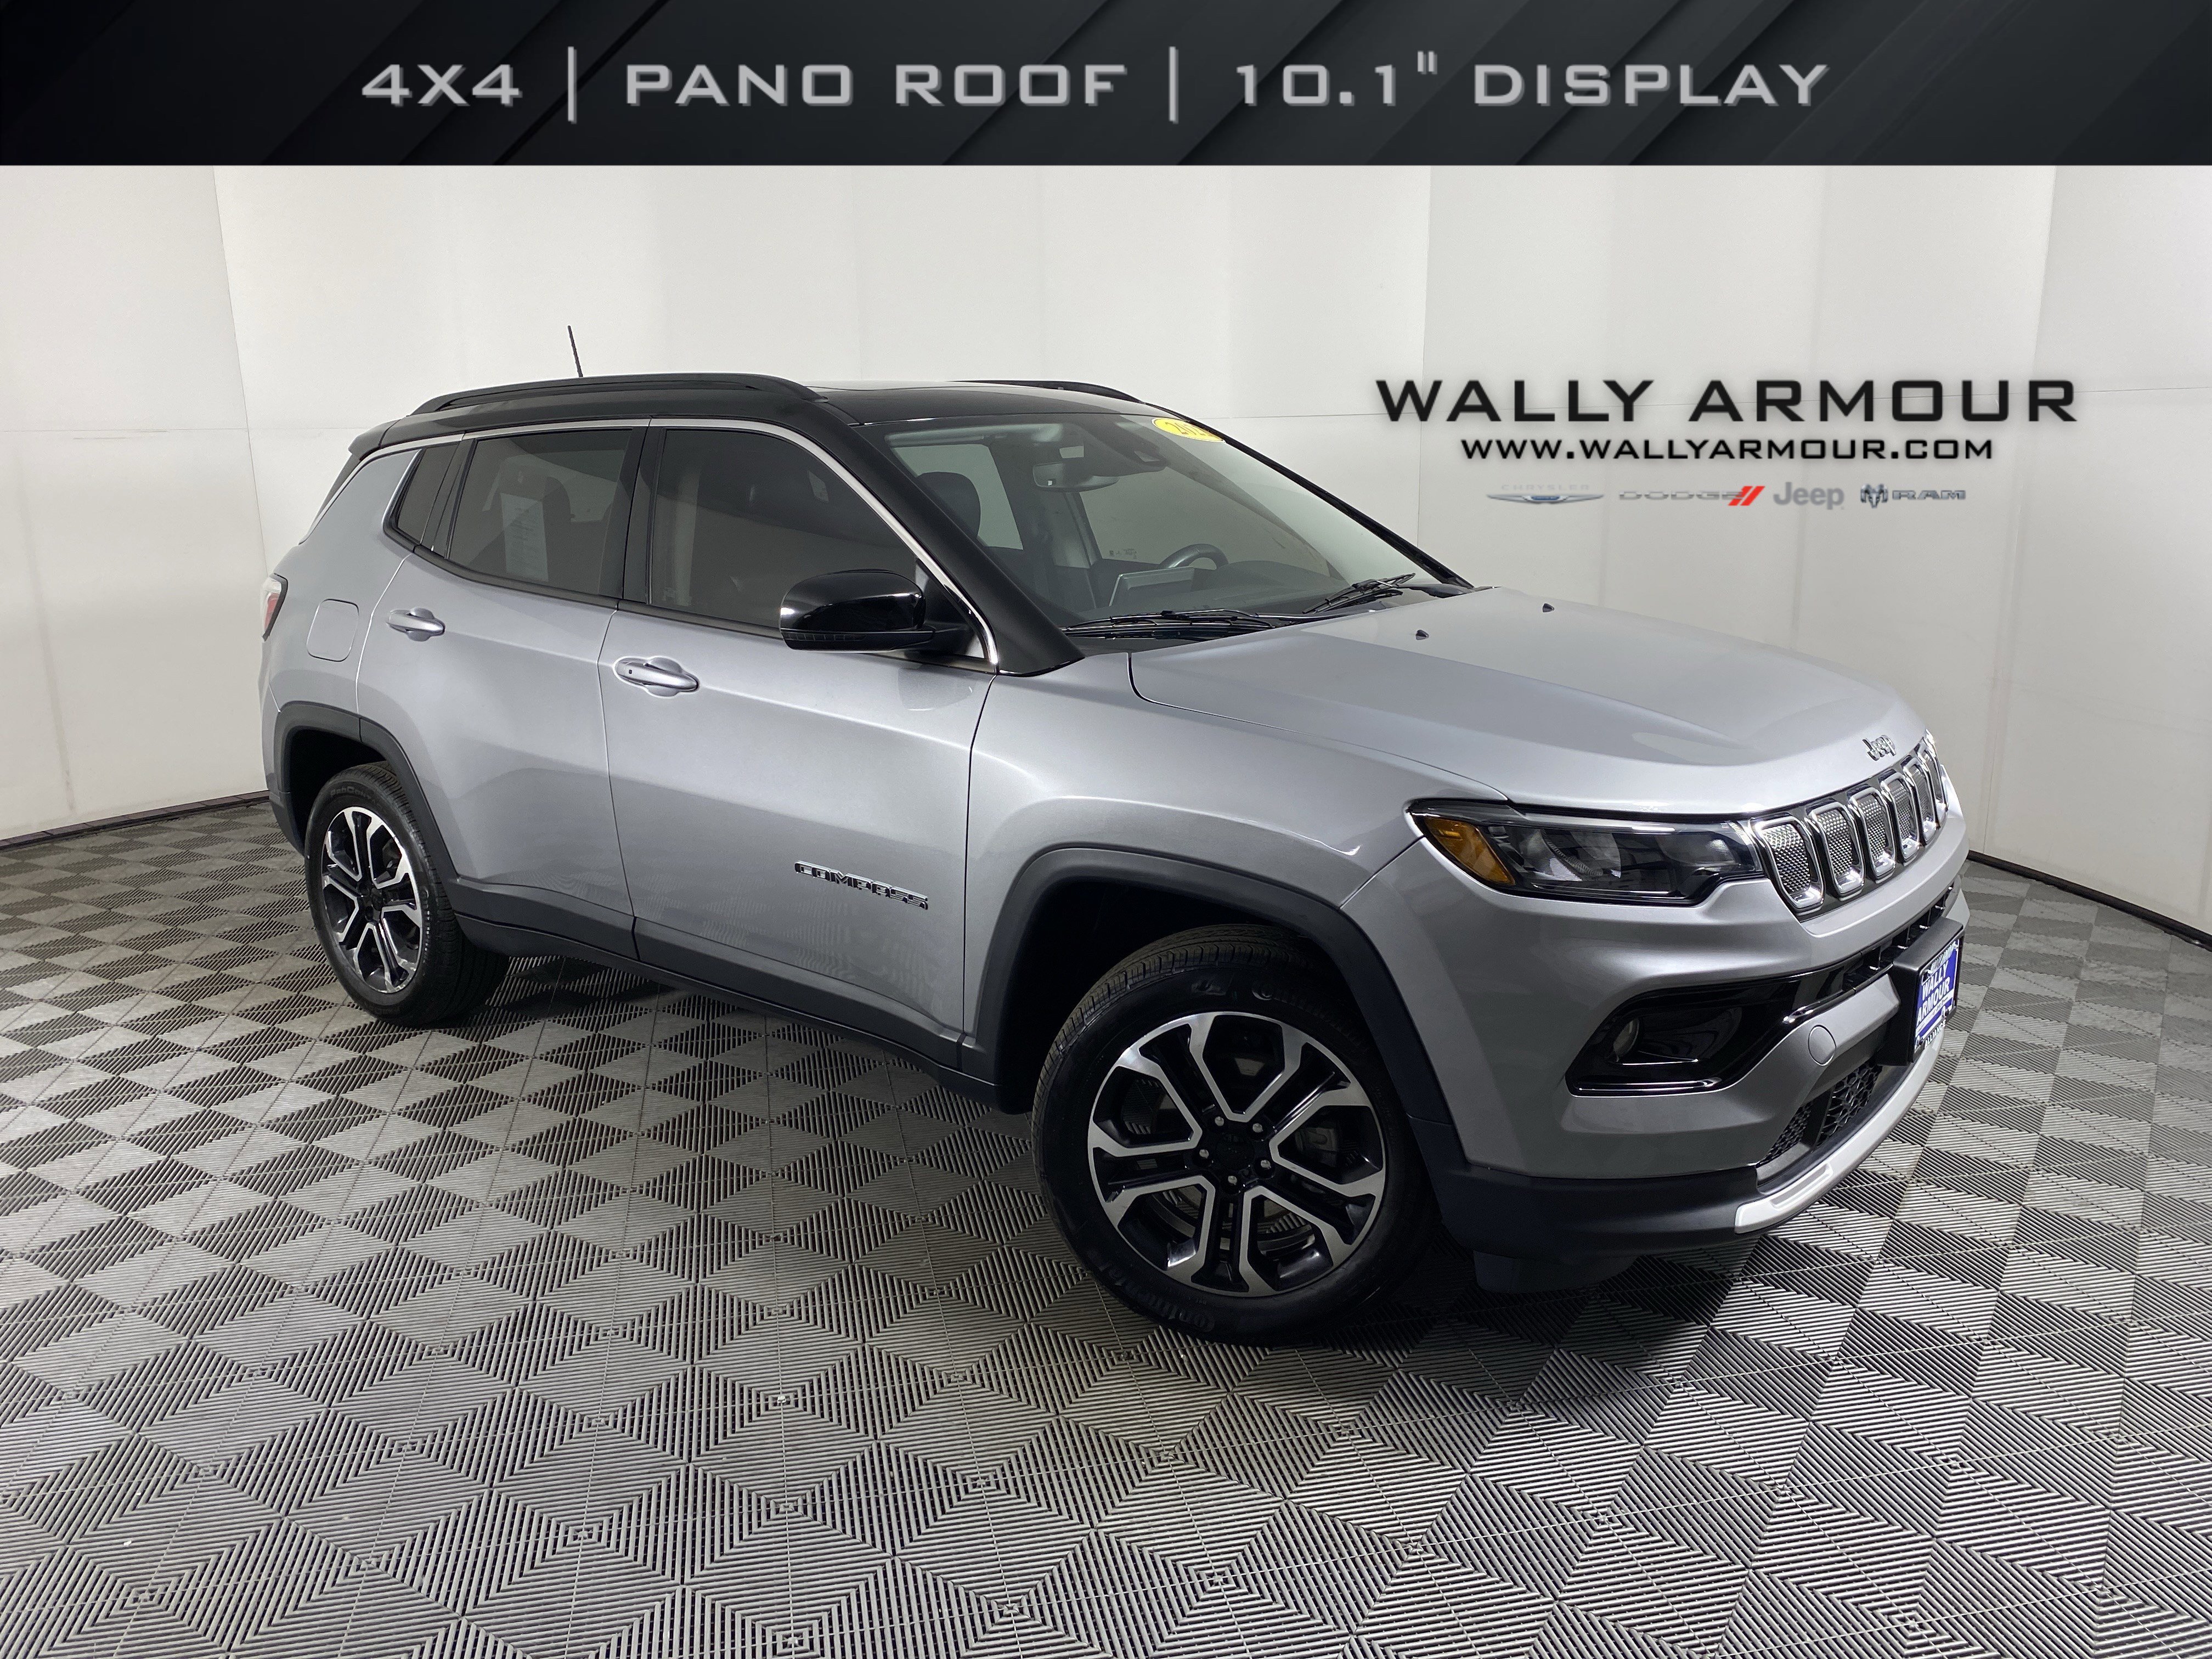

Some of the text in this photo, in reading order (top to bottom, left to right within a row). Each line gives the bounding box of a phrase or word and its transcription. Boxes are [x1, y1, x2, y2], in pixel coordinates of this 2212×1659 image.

[1862, 735, 1897, 761] Jeep
[794, 860, 929, 911] COMPASS
[1916, 977, 1950, 1028] ARMOUR
[1922, 960, 1949, 1001] WALLY
